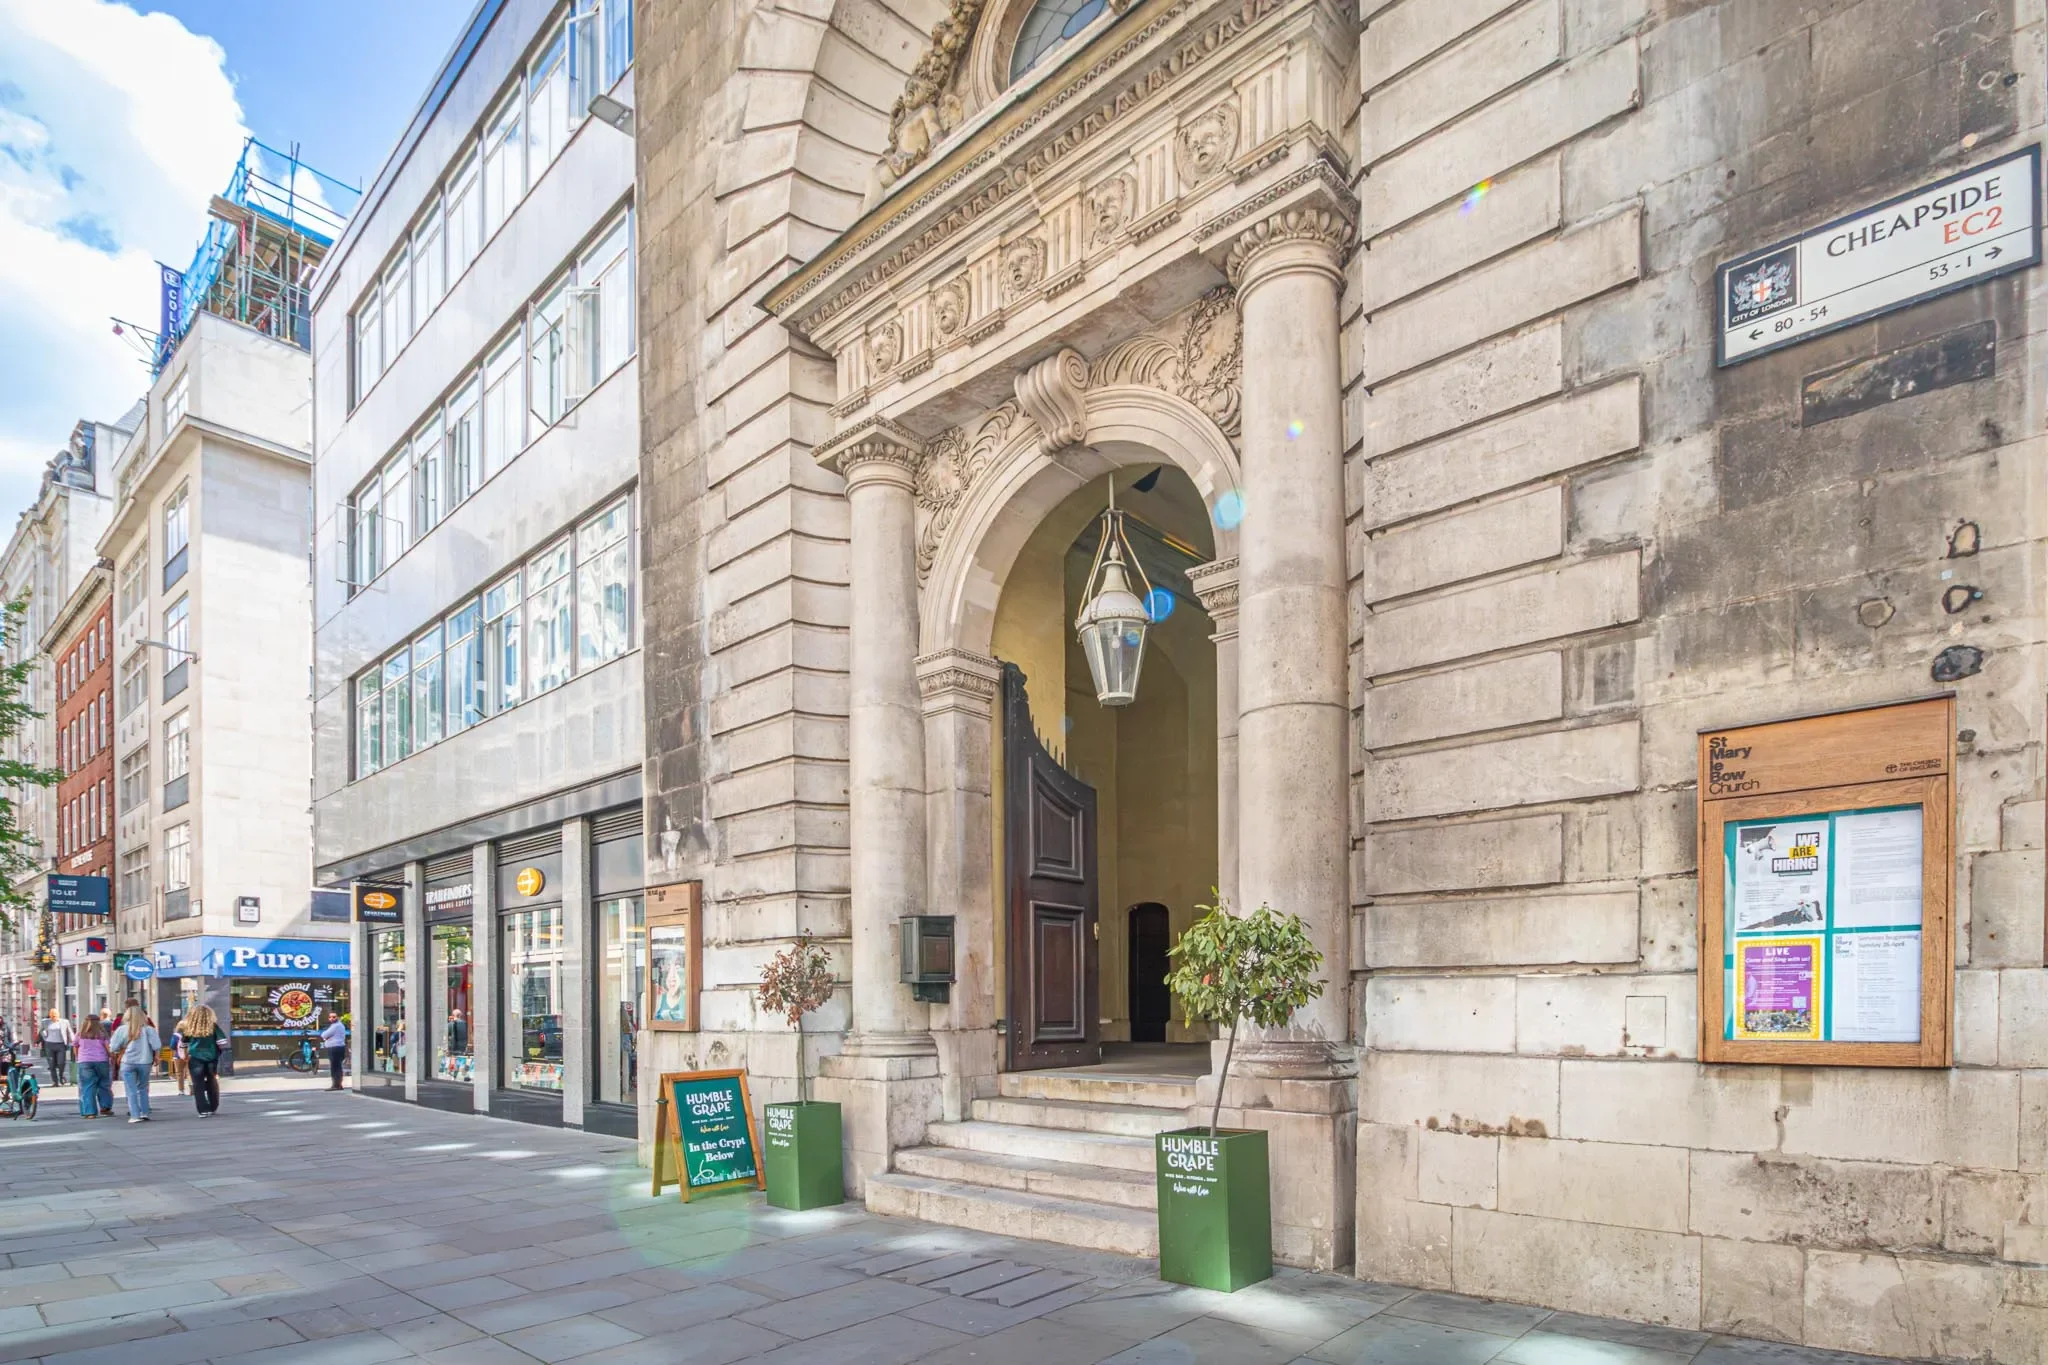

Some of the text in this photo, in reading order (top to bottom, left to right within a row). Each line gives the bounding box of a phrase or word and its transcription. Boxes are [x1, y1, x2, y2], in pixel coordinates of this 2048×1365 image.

[1827, 177, 2002, 257] CHEAPSIDE
[1944, 206, 2003, 244] EC2
[1929, 263, 1949, 281] 53
[1732, 296, 1793, 323] CITY OF LONDON
[1774, 317, 1794, 333] 80
[1810, 305, 1829, 321] 54
[1709, 736, 1728, 749] St
[1710, 746, 1752, 761] Mary
[1710, 760, 1725, 772] le
[1909, 763, 1942, 772] ENGLAND
[1912, 758, 1942, 766] CHURCH
[1710, 769, 1746, 783] Bow
[1709, 778, 1760, 795] Church
[1797, 834, 1820, 847] WE
[1792, 846, 1812, 858] ARE
[1773, 858, 1817, 872] HIRING
[231, 946, 319, 970] Pure.
[1765, 947, 1790, 956] LIVE
[268, 982, 311, 1005] All round
[251, 1042, 280, 1050] Pure.
[686, 1090, 733, 1105] HUMBLE
[692, 1101, 731, 1116] GRAPE
[767, 1107, 794, 1120] HUMBLE
[769, 1118, 792, 1131] GRAPE
[688, 1137, 746, 1152] In the Crypt
[1161, 1137, 1219, 1155] HUMBLE
[705, 1151, 735, 1162] Below
[1167, 1153, 1214, 1171] GRAPE
